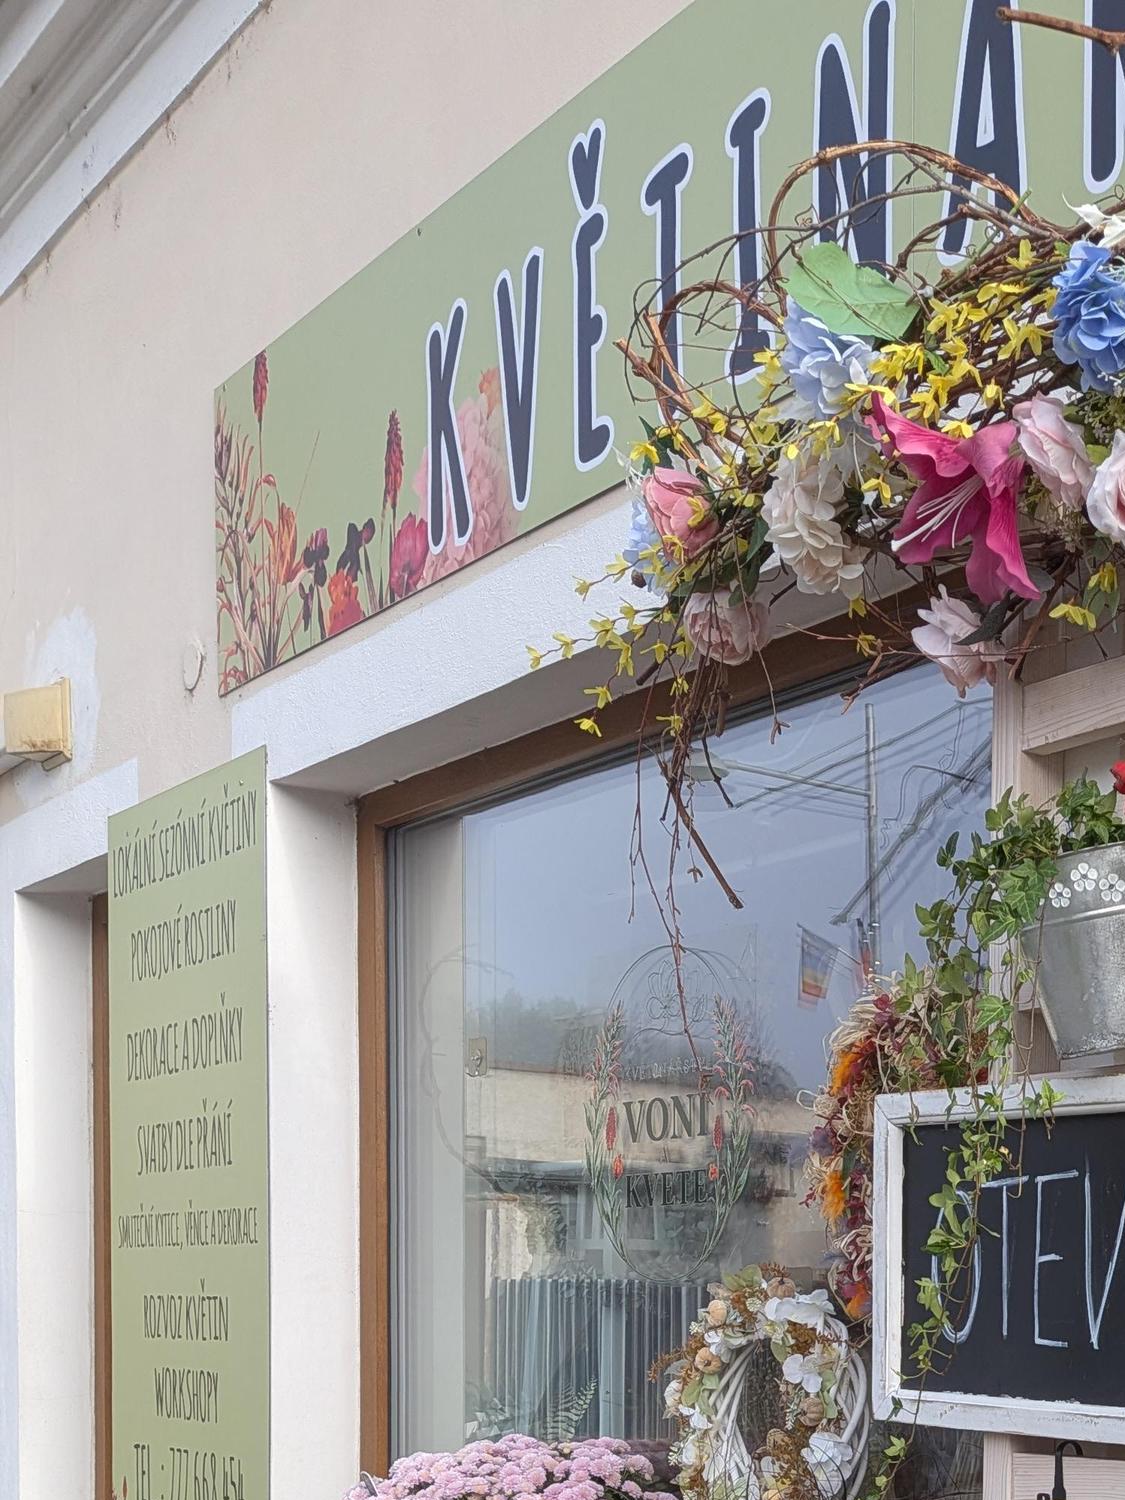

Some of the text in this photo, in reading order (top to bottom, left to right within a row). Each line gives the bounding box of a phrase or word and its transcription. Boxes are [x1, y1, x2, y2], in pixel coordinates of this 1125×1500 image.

[113, 784, 257, 898] LOKÁLNÍ SEZÓNNÍ KVĚTINY
[131, 900, 237, 982] POKOJOVÉ ROSTLINY
[127, 992, 243, 1082] DEKORACE A DOPLŇKY
[137, 1098, 233, 1176] SVATBY DLE PŘÁNÍ
[118, 1203, 155, 1249] SMUTEČNÍ
[184, 1200, 208, 1246] VĚNCE
[210, 1210, 217, 1245] A
[218, 1207, 258, 1246] DEKORACE
[143, 1278, 228, 1342] ROZVOZ KVĚTIN
[154, 1367, 218, 1424] WORKSHOPY
